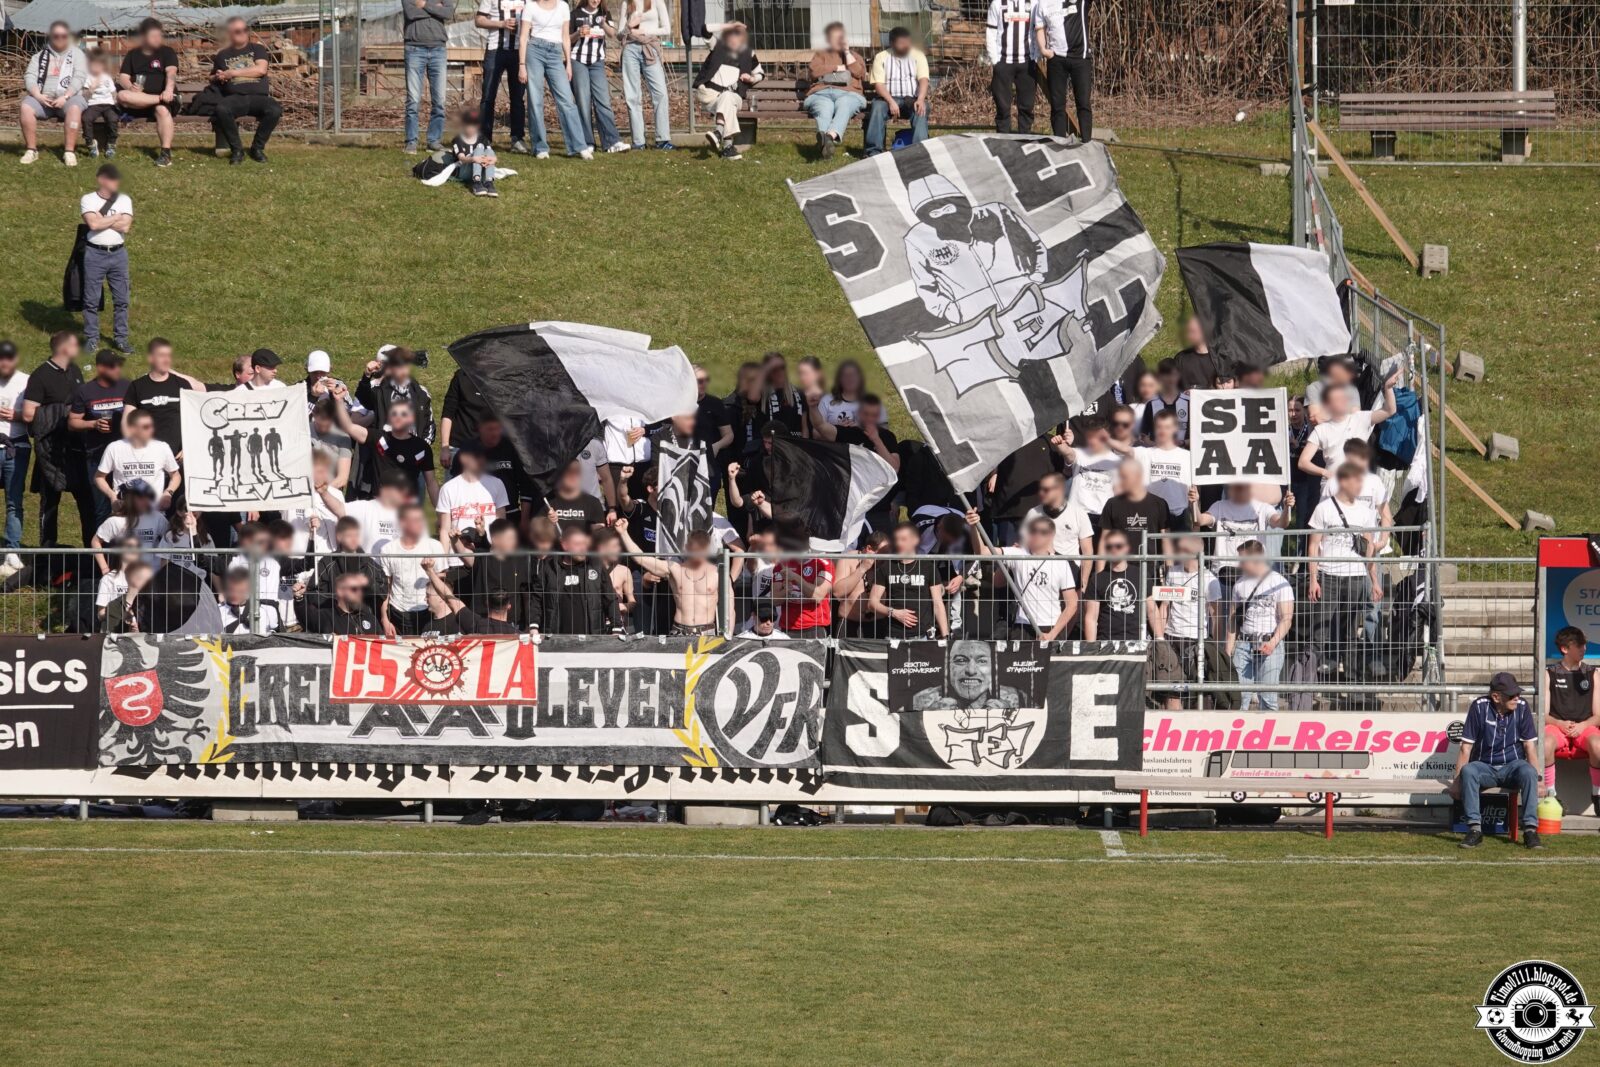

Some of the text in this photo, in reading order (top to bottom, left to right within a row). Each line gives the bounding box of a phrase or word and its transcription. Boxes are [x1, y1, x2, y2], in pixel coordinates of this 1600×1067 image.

[801, 189, 888, 282] S
[200, 396, 289, 431] CREW
[1201, 397, 1277, 434] SE
[1194, 438, 1283, 476] AA
[188, 475, 312, 508] ELEVEN
[475, 640, 537, 699] LA
[891, 666, 942, 675] STADIONVERBOT
[1006, 665, 1045, 674] STANDHAFT
[845, 670, 1120, 762] S E
[1179, 766, 1193, 774] und
[1231, 769, 1292, 777] Schmid-Reisen
[1393, 761, 1410, 770] wie
[1410, 761, 1424, 770] die
